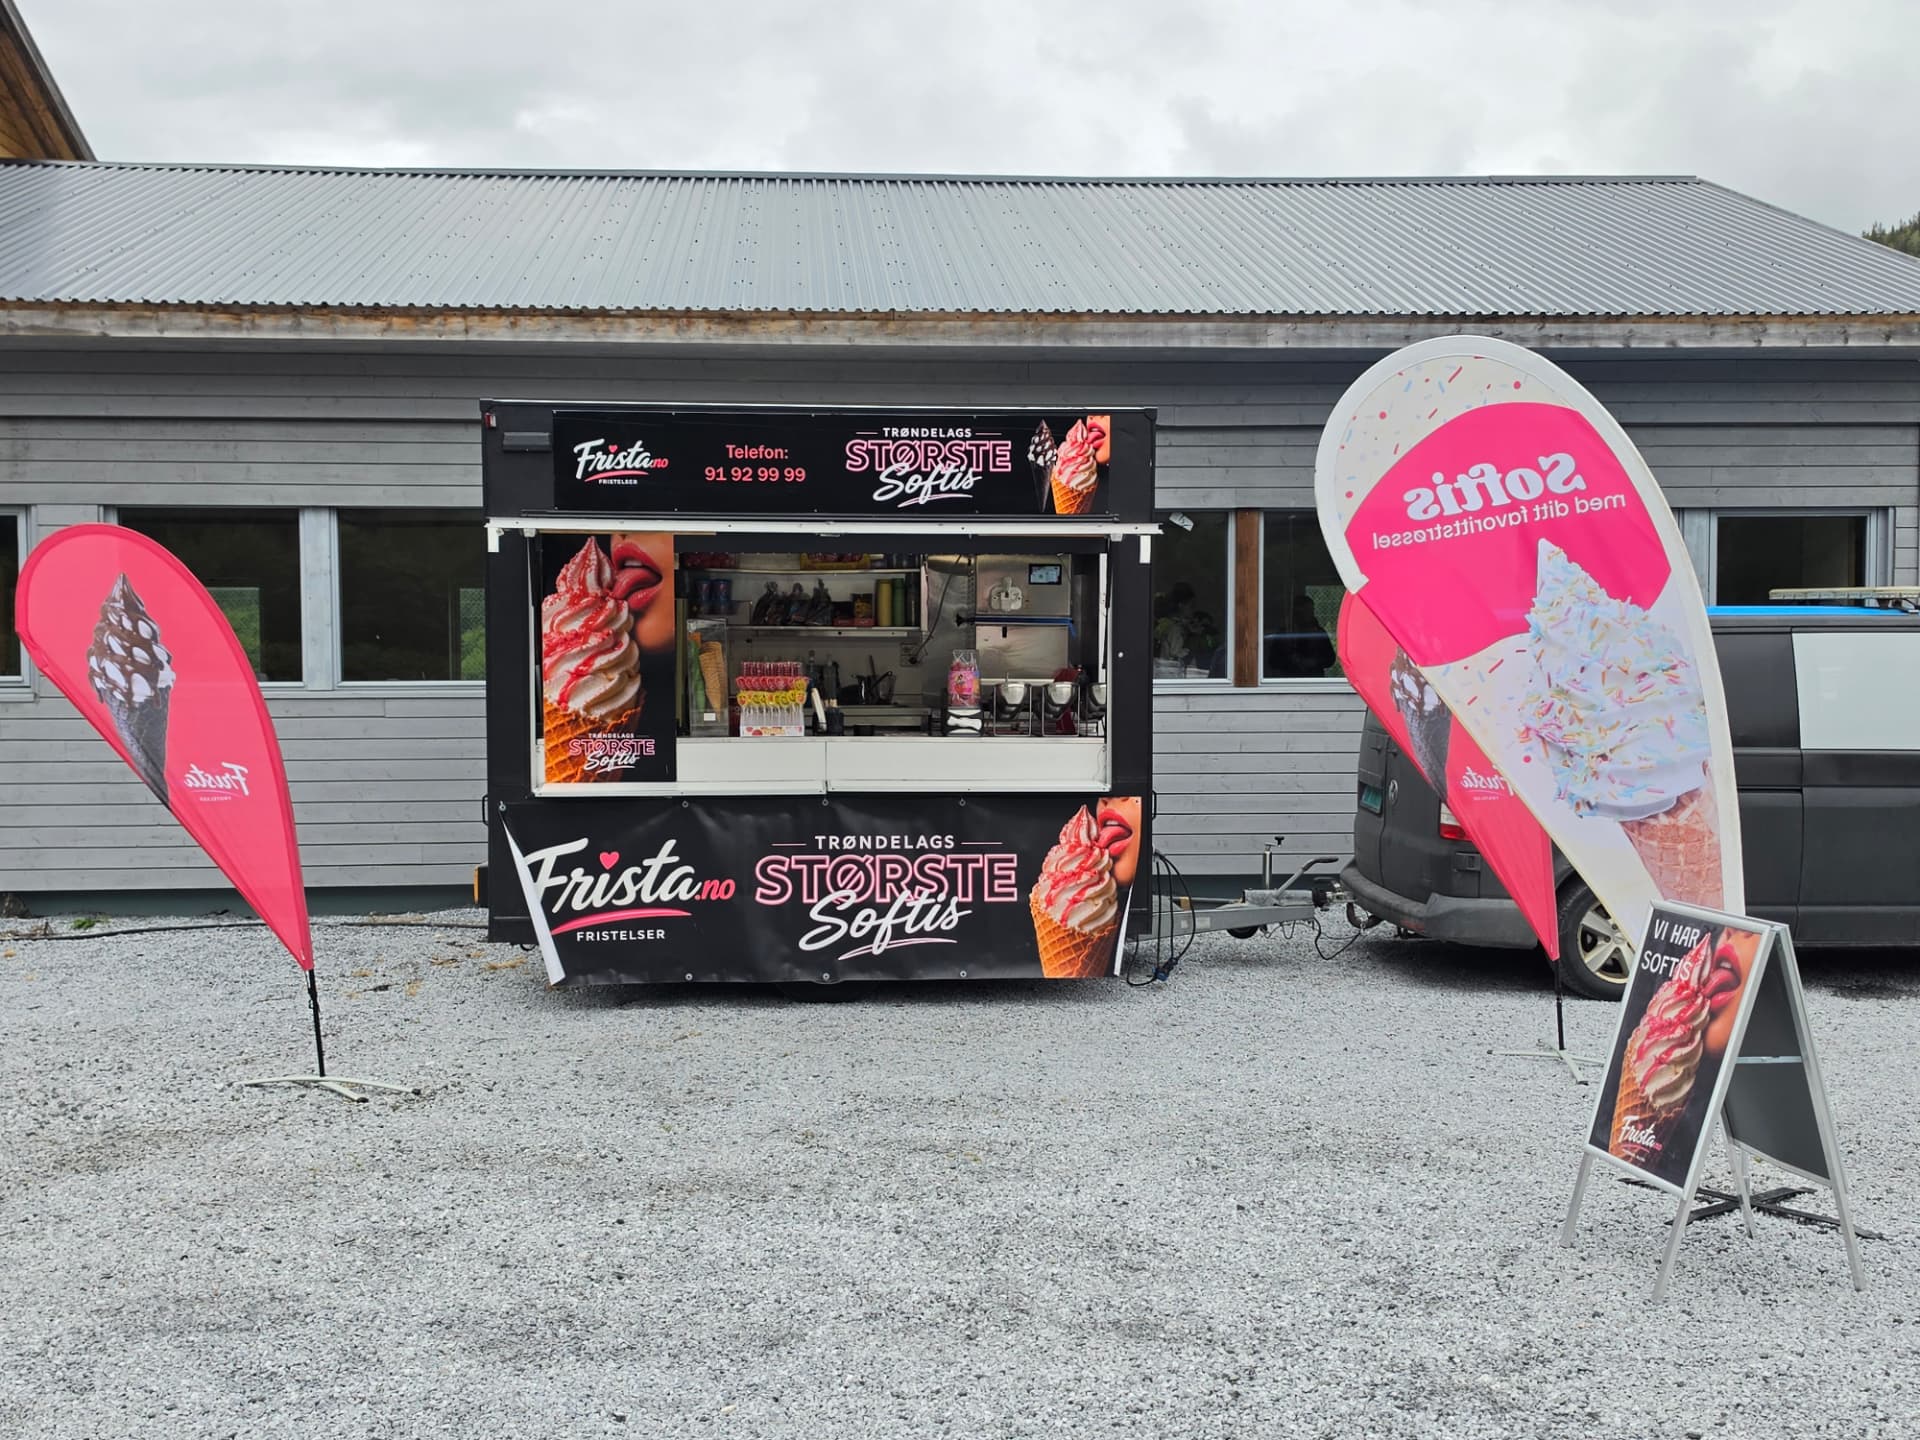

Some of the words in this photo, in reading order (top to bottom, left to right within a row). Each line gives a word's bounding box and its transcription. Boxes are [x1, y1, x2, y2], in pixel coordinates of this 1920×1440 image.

[882, 427, 972, 438] TRØNDELAGS
[725, 444, 789, 459] Telefon:
[845, 439, 1012, 472] STØRSTE
[704, 467, 727, 481] 91
[730, 467, 753, 481] 92
[757, 467, 780, 481] 99
[783, 467, 806, 482] 99
[873, 462, 983, 504] Softis
[568, 739, 655, 755] STØRSTE
[584, 749, 640, 772] Softis
[815, 835, 955, 849] TRØNDELAGS
[755, 854, 1018, 904] STØRSTE
[798, 889, 972, 955] Softis
[576, 929, 665, 941] FRISTELSER
[1654, 919, 1669, 940] VI
[1670, 924, 1700, 949] HAR
[1641, 950, 1693, 981] SOFTIS
